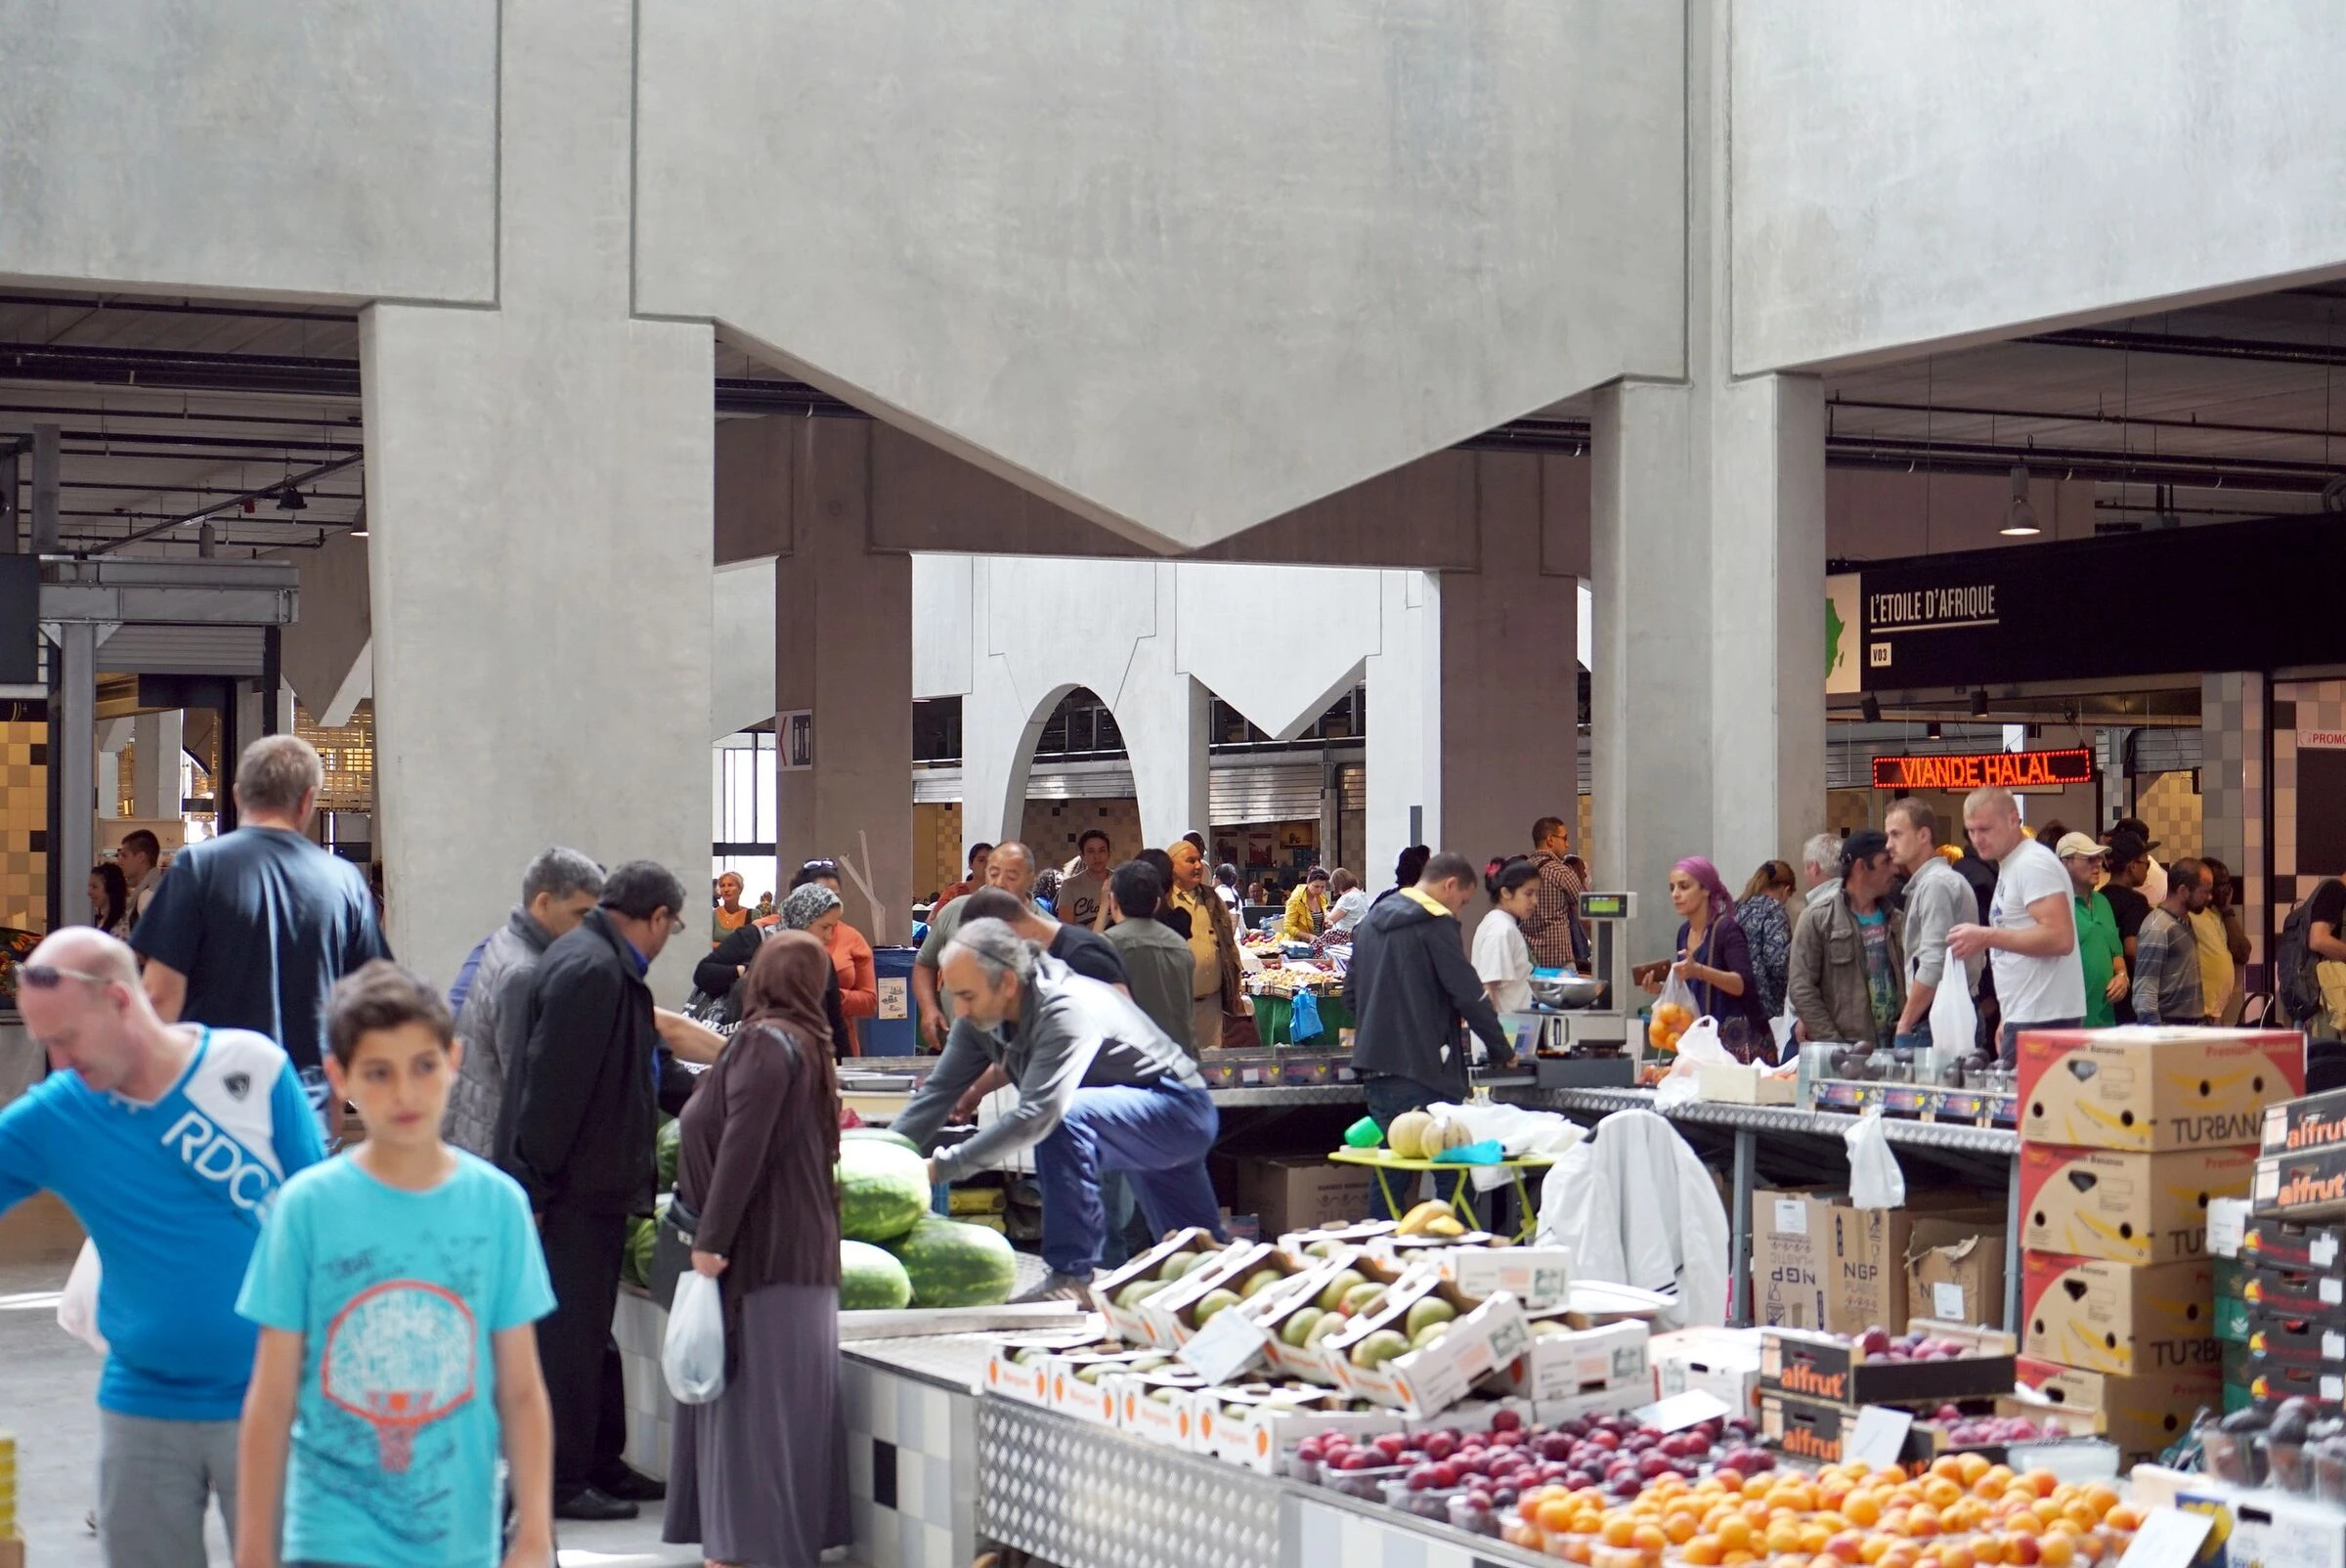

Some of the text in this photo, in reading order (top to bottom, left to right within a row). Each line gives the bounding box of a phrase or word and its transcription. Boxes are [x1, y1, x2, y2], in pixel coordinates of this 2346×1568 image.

[1900, 753, 2056, 786] VIANDE HALAL
[2278, 1173, 2345, 1206] alfrut
[1844, 1261, 1878, 1282] NGP
[1781, 1363, 1846, 1400] alfrut
